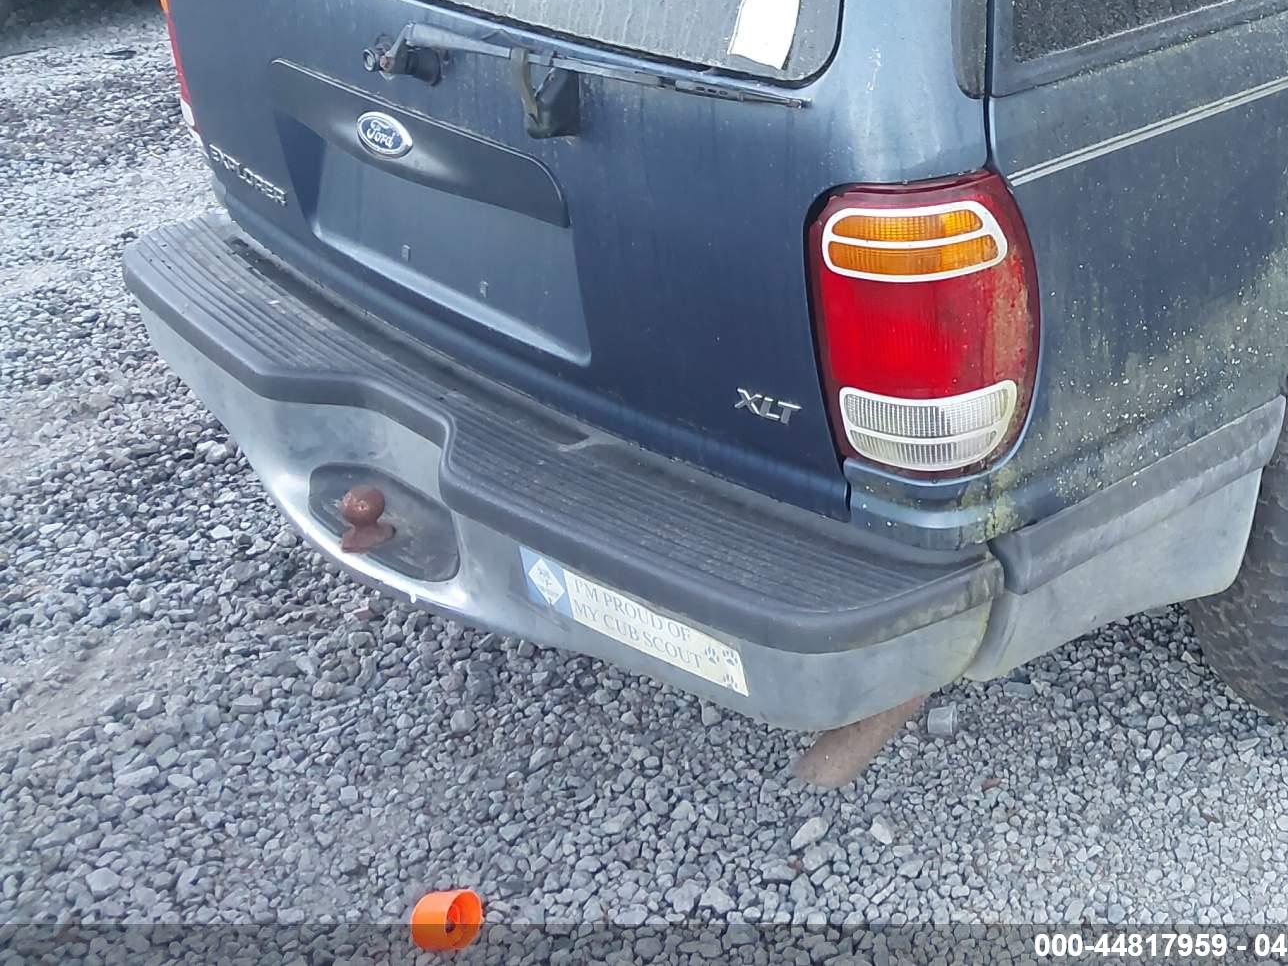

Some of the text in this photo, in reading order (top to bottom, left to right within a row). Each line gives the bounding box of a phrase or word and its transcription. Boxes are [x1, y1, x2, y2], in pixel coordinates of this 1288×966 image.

[366, 119, 396, 149] Ford
[208, 143, 287, 207] EXPLORER
[734, 387, 803, 426] XLT
[573, 598, 703, 669] MY CUB SCOUT
[574, 578, 599, 603] I'M
[603, 592, 664, 631] PROUD
[667, 620, 691, 641] OF
